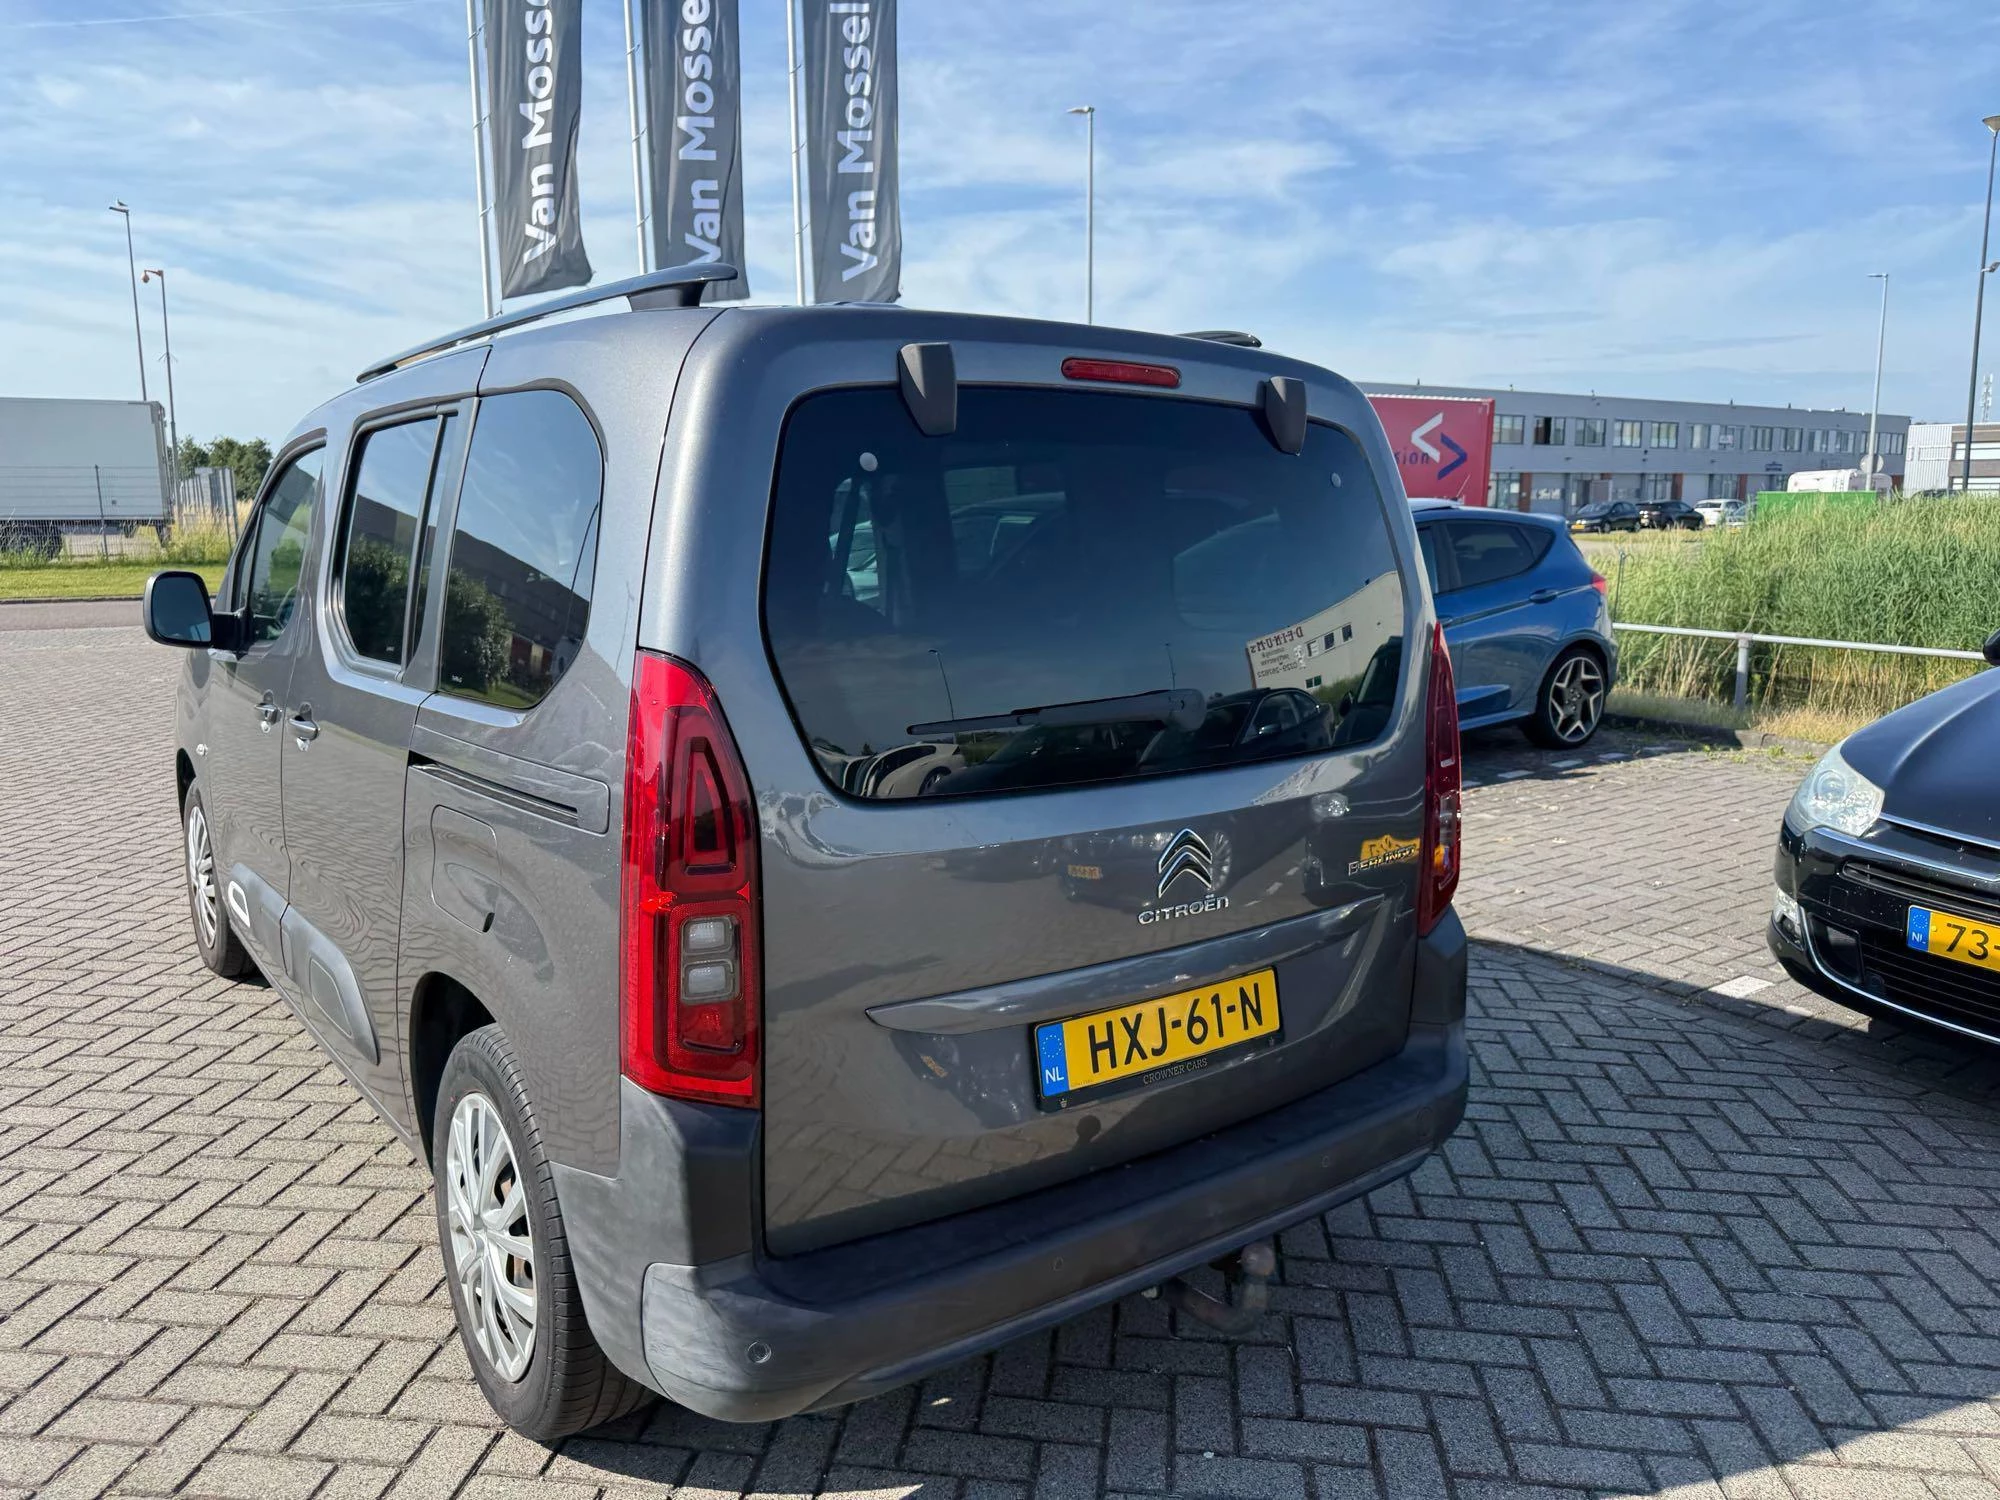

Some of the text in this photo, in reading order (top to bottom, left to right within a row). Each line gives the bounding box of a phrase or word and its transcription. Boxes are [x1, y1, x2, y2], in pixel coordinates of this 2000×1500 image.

[519, 0, 557, 265] Van Moss
[829, 3, 879, 283] Van Mossel
[683, 179, 722, 265] Van
[1911, 931, 1927, 945] NL
[1088, 982, 1263, 1074] HXJ-61-N
[1044, 1066, 1065, 1084] NL
[1143, 1057, 1208, 1086] CROWNER CARS
